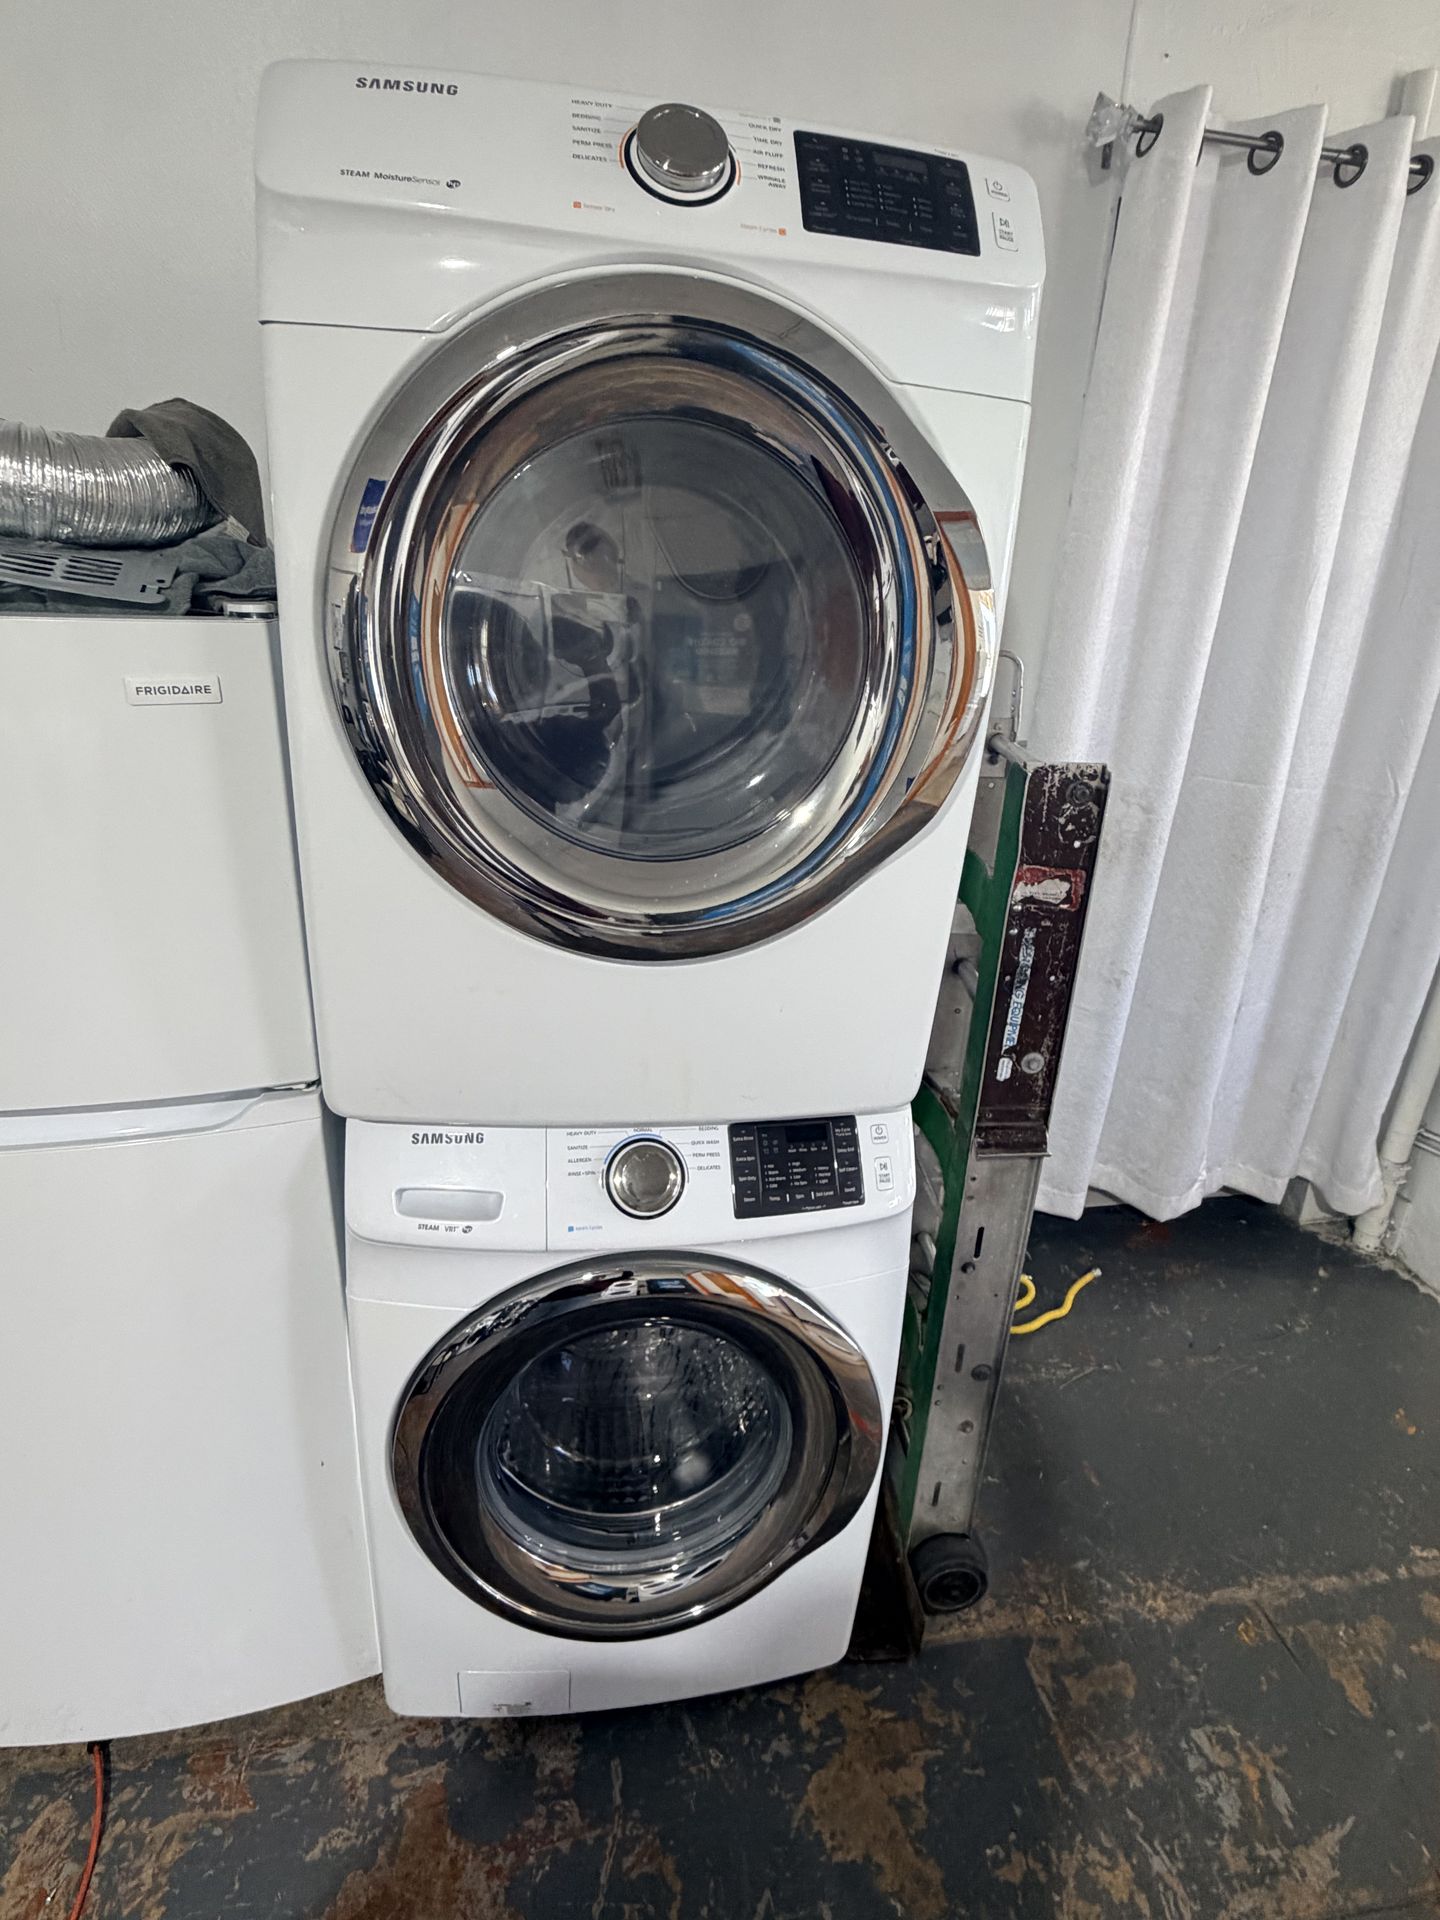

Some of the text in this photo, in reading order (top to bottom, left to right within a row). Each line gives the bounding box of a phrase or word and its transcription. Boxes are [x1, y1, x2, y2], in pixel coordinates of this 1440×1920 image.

[355, 77, 459, 96] SAMSUNG
[572, 125, 601, 134] SANITIZE
[572, 138, 613, 150] PERM PRESS
[572, 153, 608, 163] DELICATES
[340, 168, 371, 179] STEAM
[135, 684, 212, 696] FRIGIDAIRE
[411, 1132, 485, 1145] SAMSUNG
[418, 1223, 440, 1231] STEAM
